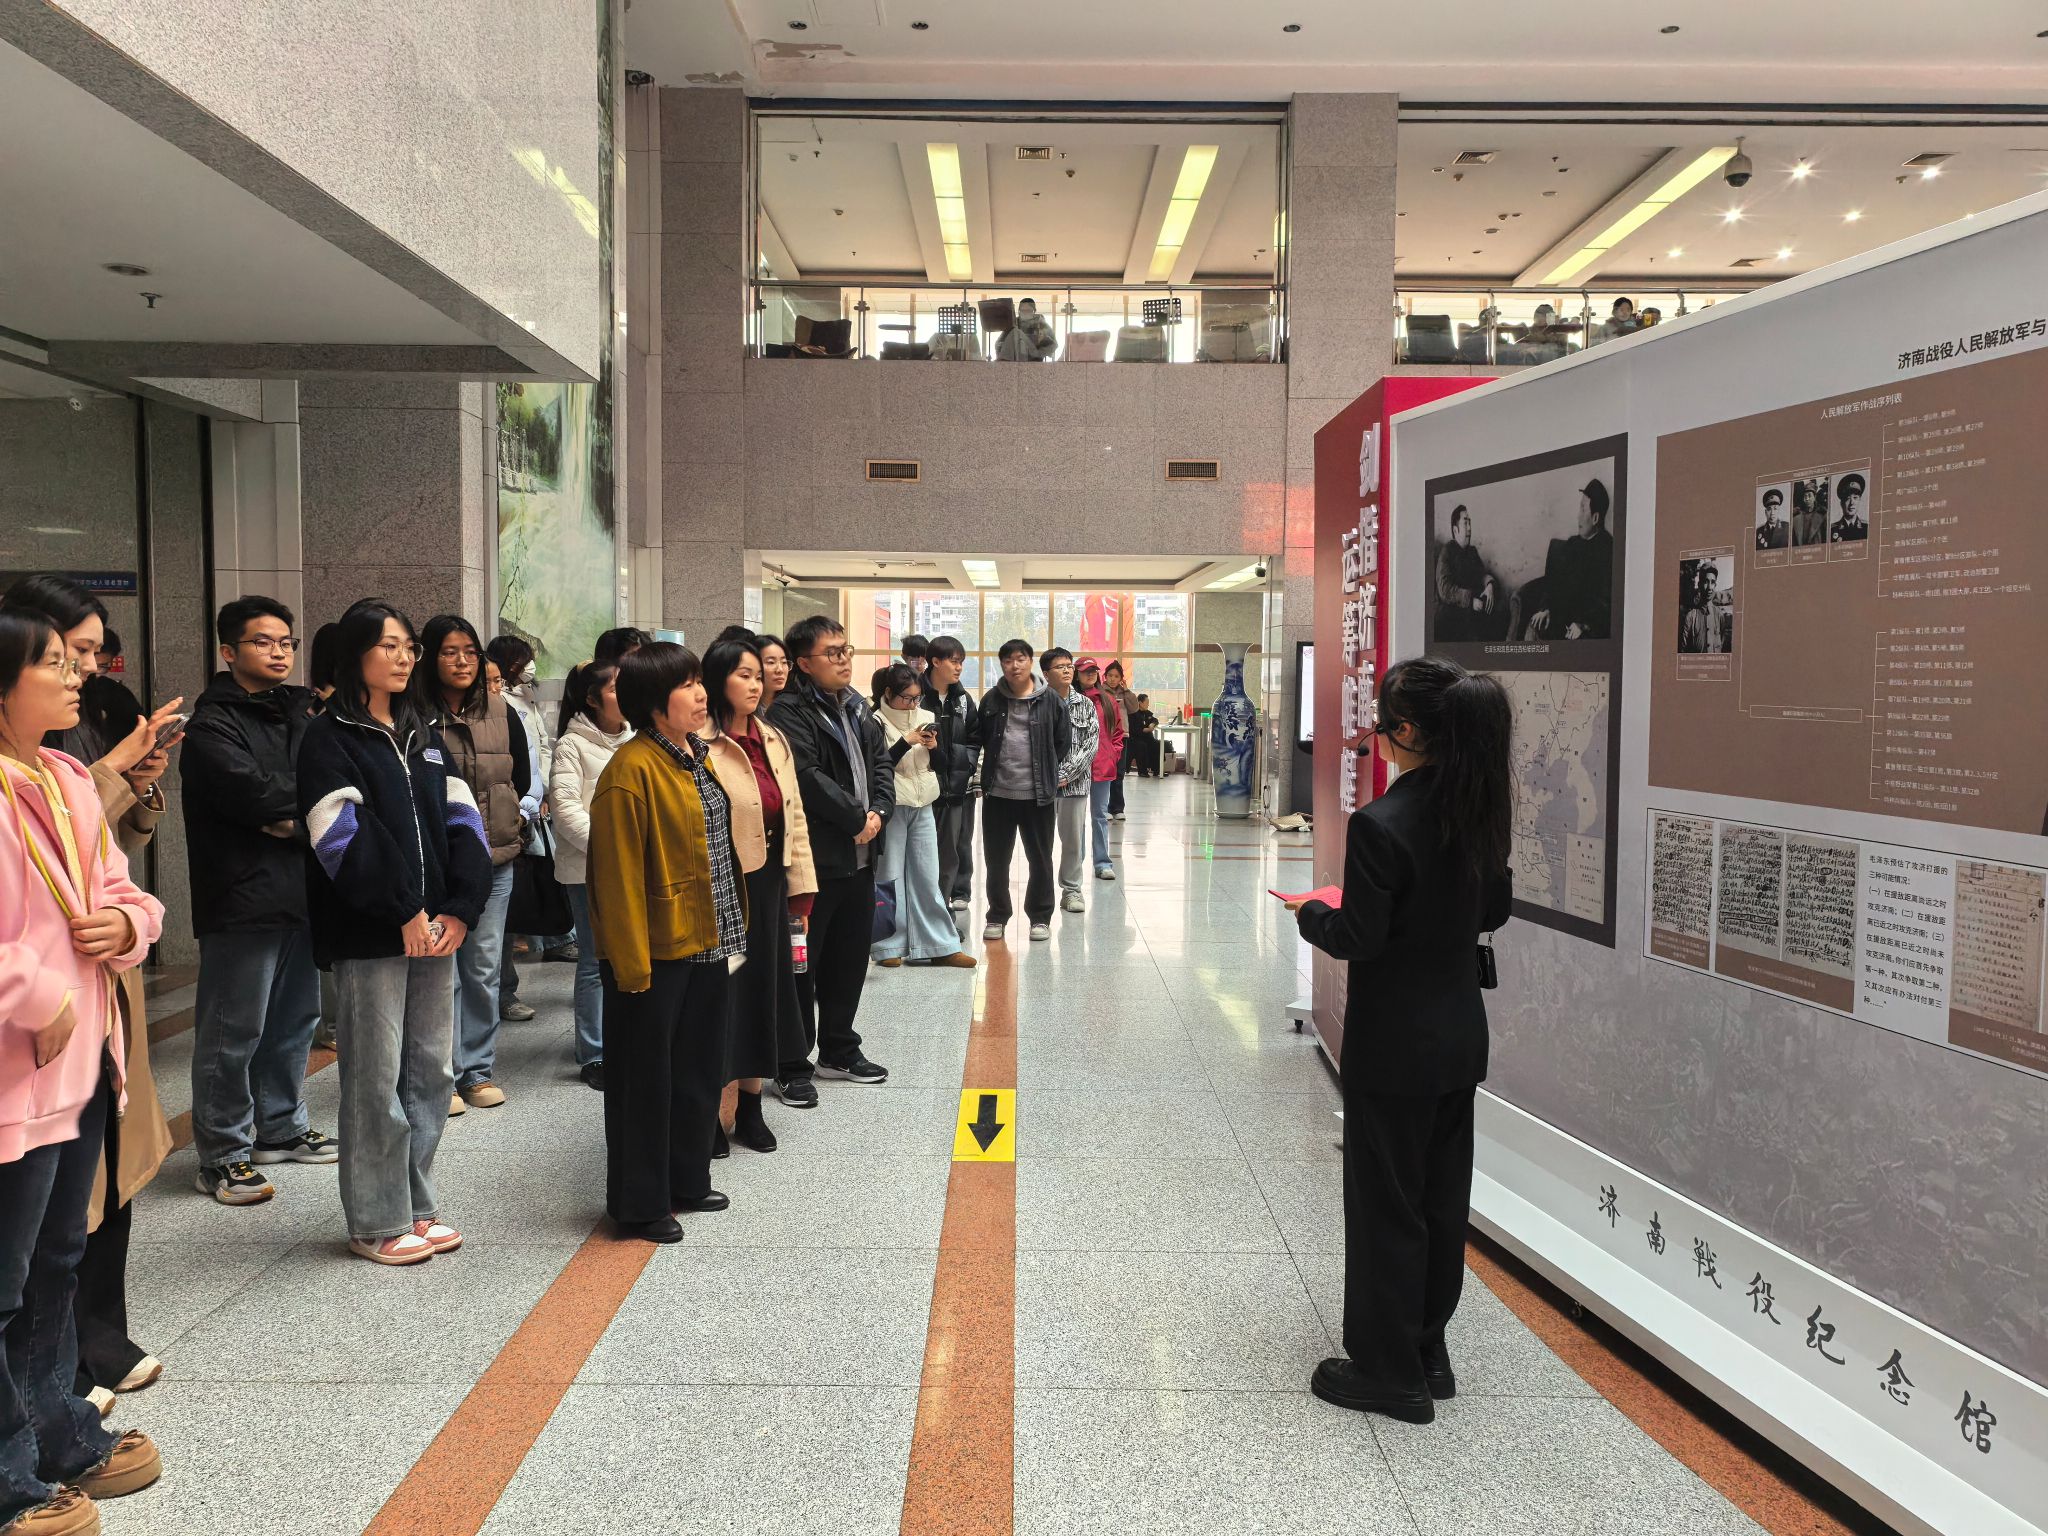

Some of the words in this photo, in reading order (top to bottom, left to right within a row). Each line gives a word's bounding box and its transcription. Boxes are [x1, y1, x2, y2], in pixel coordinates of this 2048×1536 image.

[1897, 318, 2047, 370] 济南战役人民解放军与
[1820, 392, 1903, 420] 人民解放军作战序列表
[1869, 855, 1948, 876] 毛泽东预估了攻济打援的
